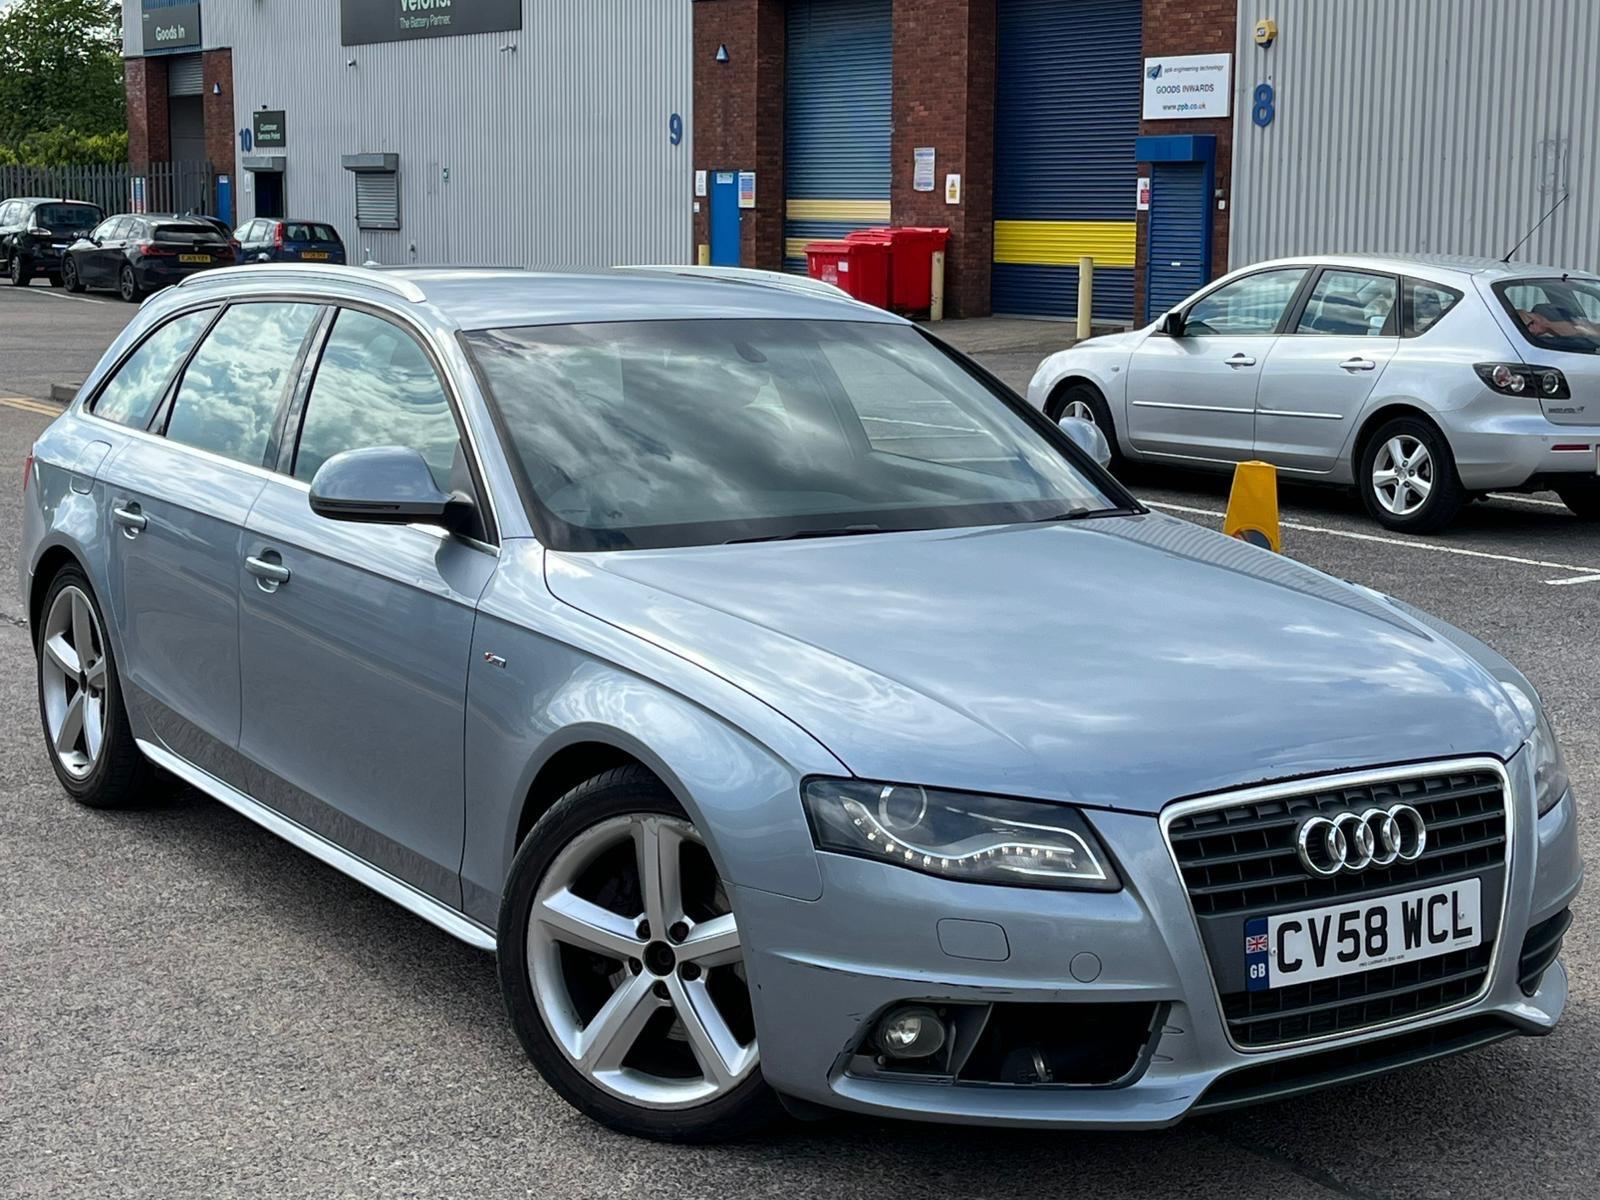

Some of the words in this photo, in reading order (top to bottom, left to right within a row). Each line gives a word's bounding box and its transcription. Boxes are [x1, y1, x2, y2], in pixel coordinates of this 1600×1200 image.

[155, 25, 178, 41] Goods
[178, 24, 185, 39] In
[1156, 85, 1181, 95] GOODS
[1182, 84, 1214, 93] INWARDS
[1253, 84, 1274, 128] 8
[239, 128, 252, 152] 10
[670, 113, 683, 146] 9
[1276, 906, 1388, 974] CV58
[1401, 890, 1473, 951] WCL
[1250, 963, 1266, 979] GB
